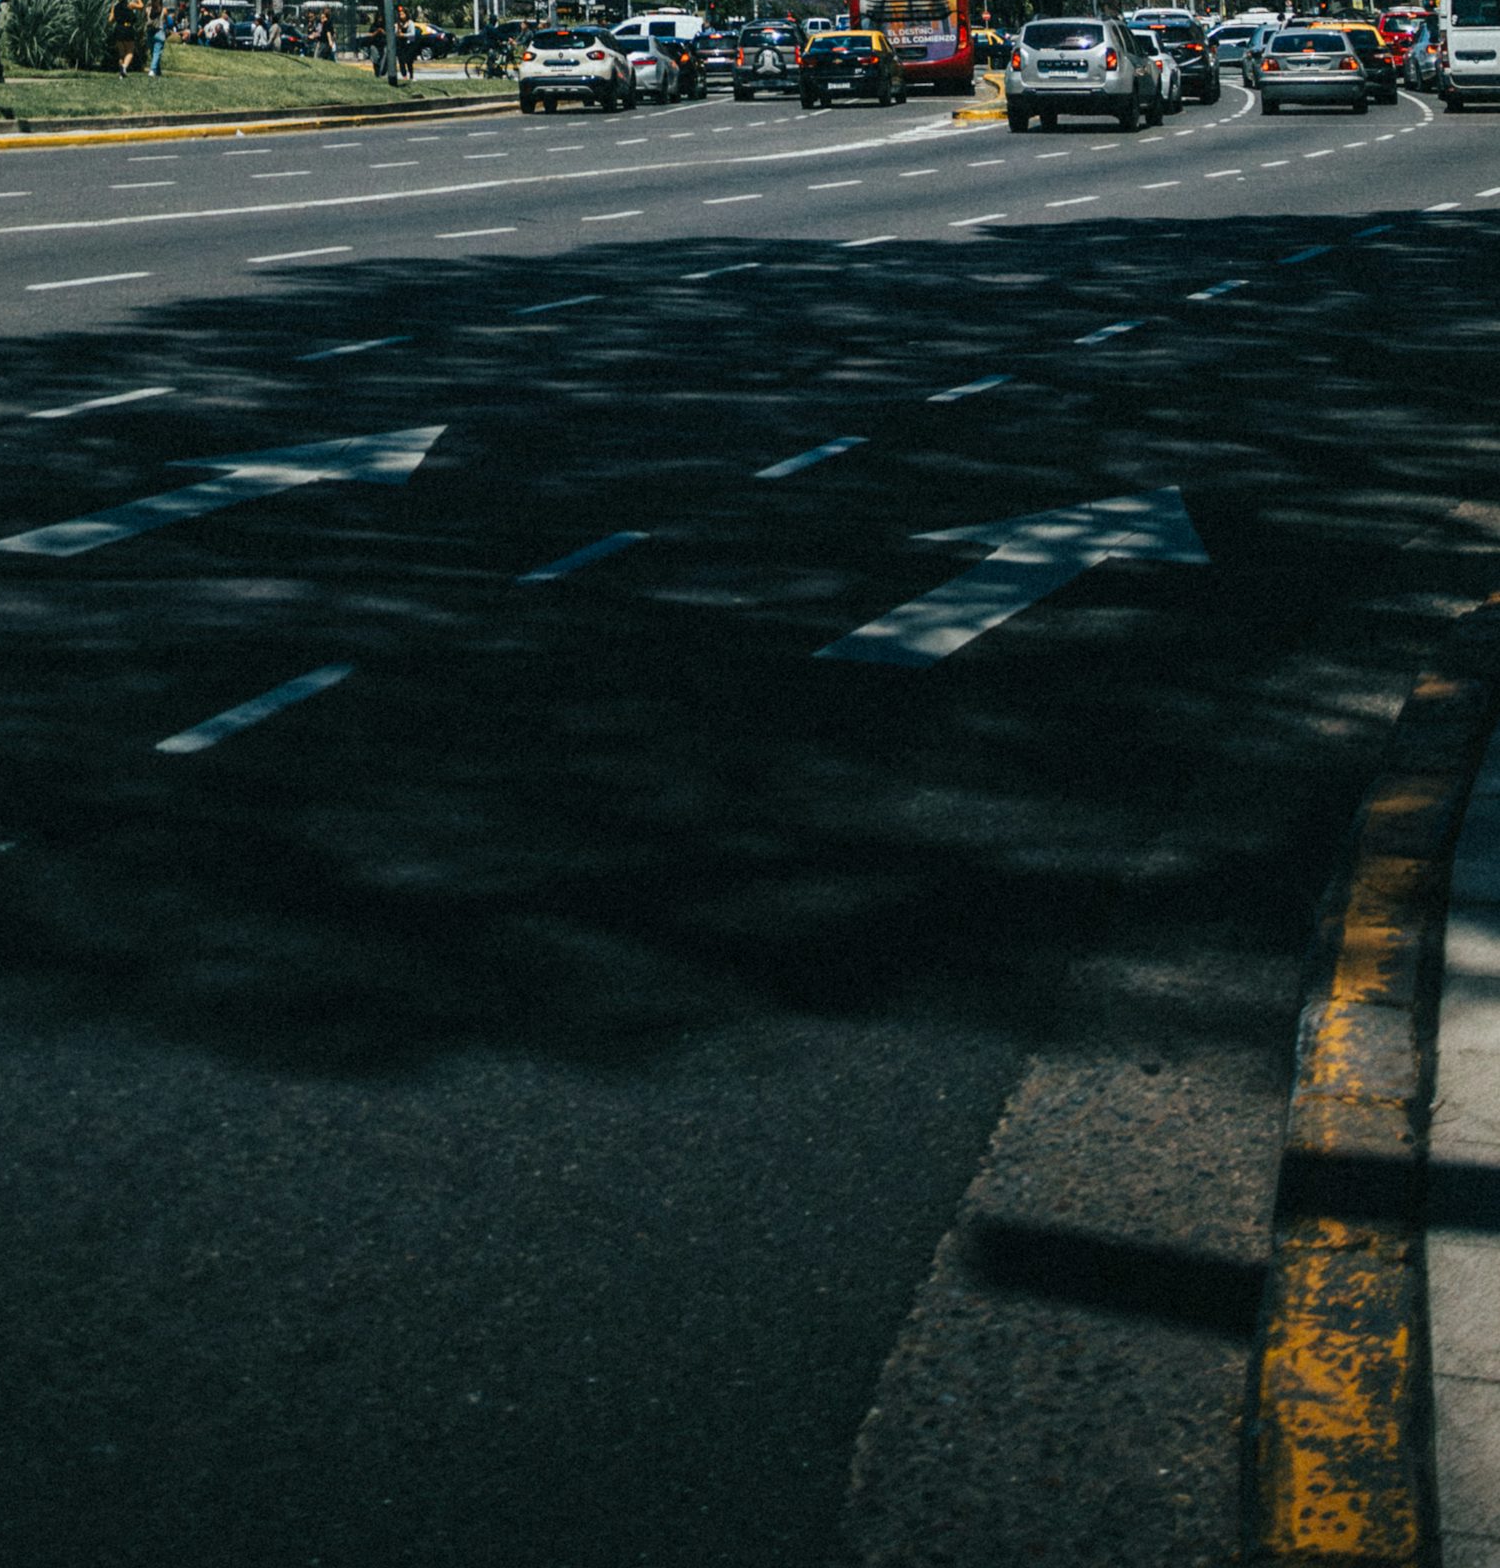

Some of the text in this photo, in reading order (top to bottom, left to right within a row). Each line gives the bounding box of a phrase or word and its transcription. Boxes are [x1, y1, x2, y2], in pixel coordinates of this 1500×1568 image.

[899, 27, 933, 36] DESTINO
[901, 36, 912, 44] EL
[912, 34, 956, 43] COMIENZO
